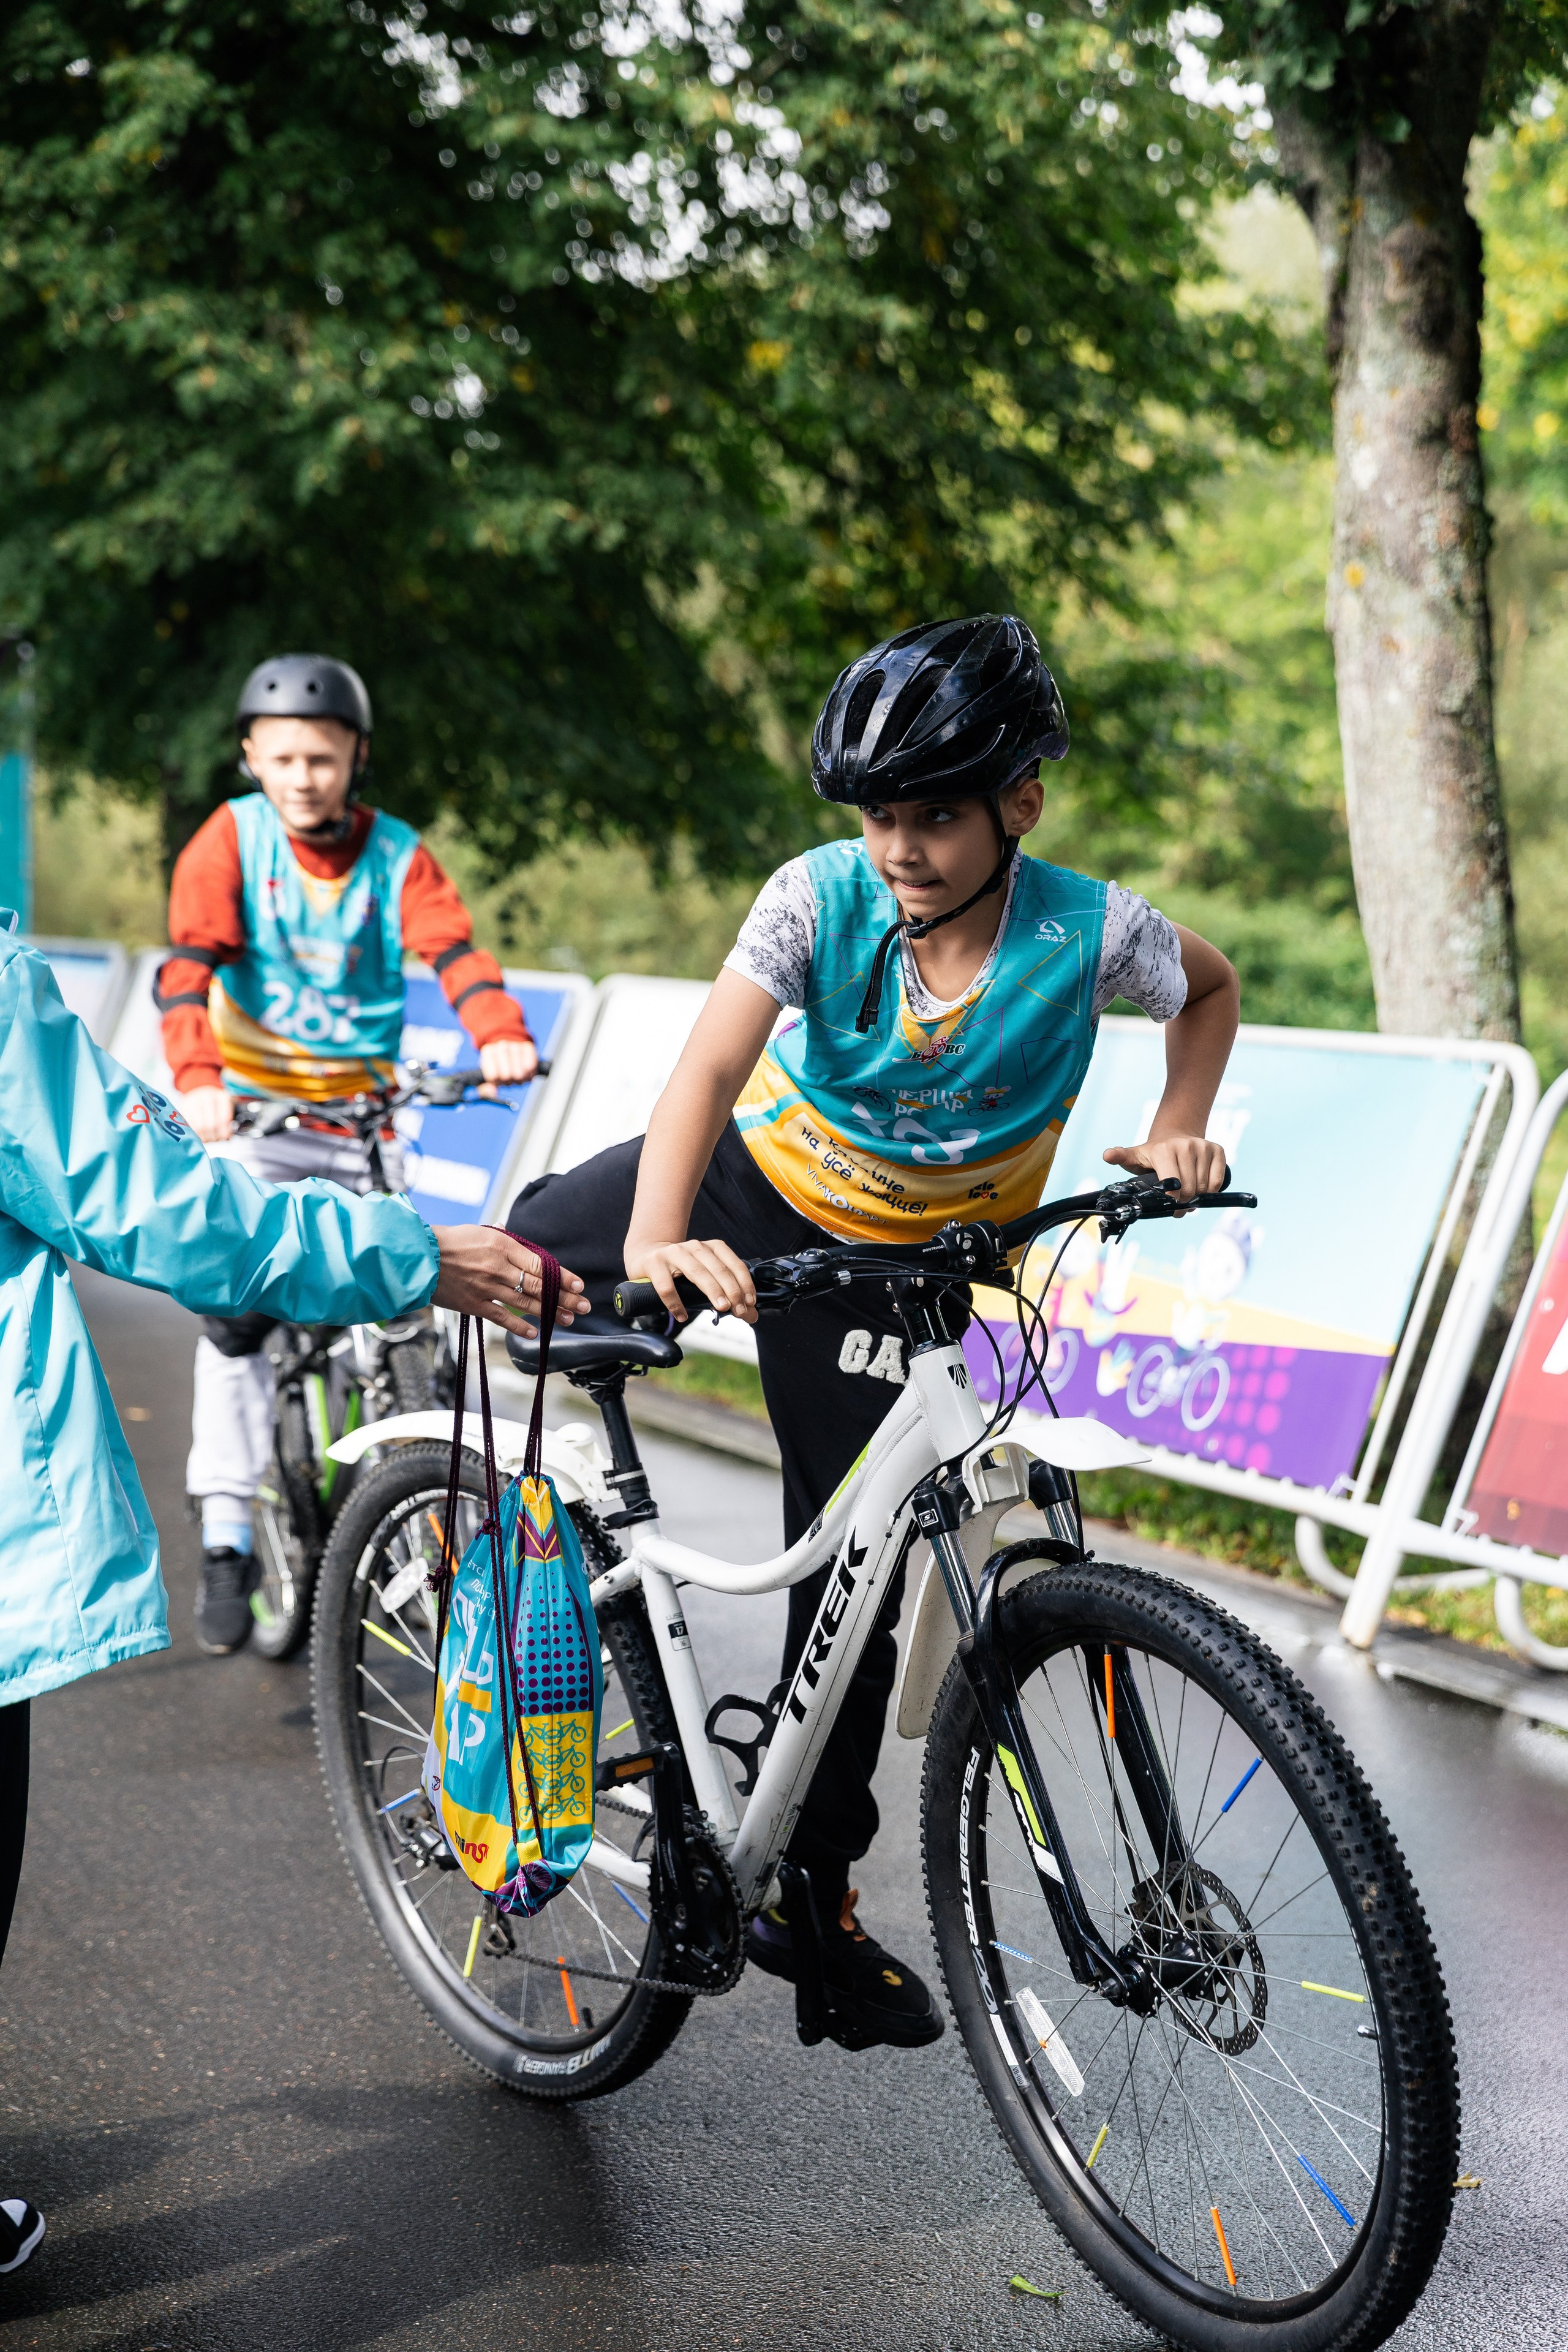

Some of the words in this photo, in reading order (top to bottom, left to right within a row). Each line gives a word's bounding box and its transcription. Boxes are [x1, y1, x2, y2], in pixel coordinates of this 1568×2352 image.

[838, 1329, 909, 1387] GA
[783, 1525, 869, 1724] TREK
[960, 1746, 980, 1947] FELGEBIETER
